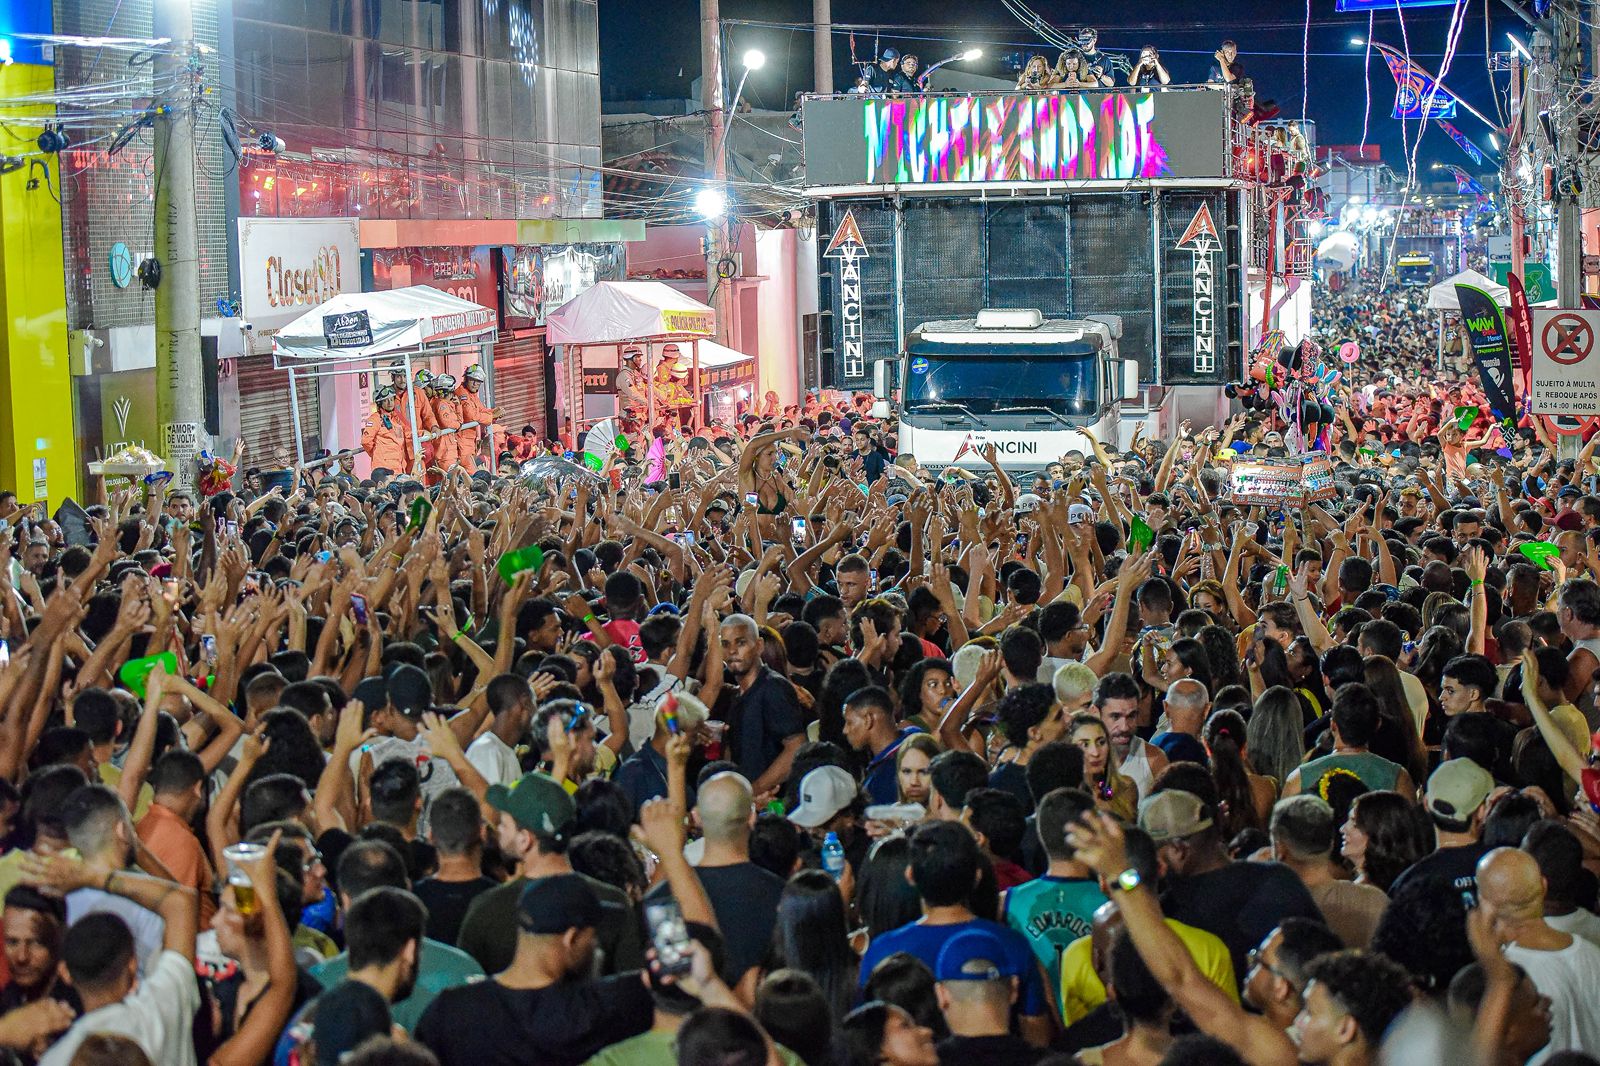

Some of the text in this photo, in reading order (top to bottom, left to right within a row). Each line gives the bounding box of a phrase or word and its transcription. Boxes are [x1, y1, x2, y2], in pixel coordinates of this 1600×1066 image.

[434, 313, 465, 334] BOMBEIRO
[465, 310, 488, 326] MILITAR
[690, 316, 707, 330] MILITAR
[1572, 380, 1596, 388] MULTA
[1579, 391, 1598, 399] APÓS
[1572, 402, 1597, 410] HORAS
[171, 424, 192, 433] AMOR
[167, 434, 196, 443] DE VOLTA
